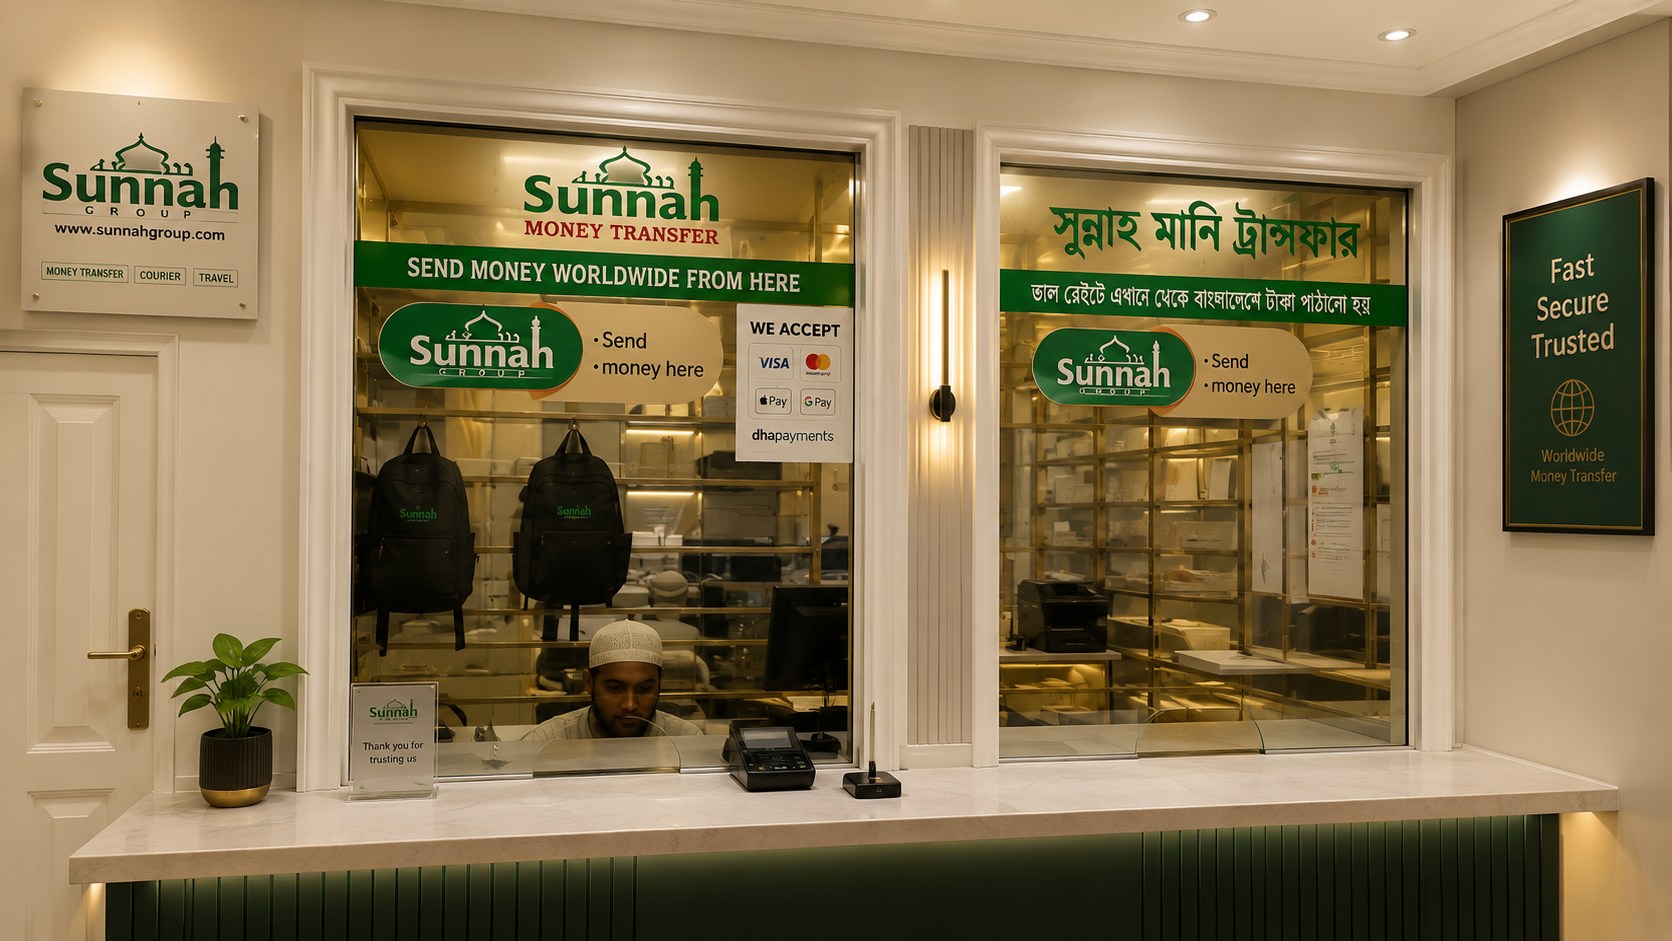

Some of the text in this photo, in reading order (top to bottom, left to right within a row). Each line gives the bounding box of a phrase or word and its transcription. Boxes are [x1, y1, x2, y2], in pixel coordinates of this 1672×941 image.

[42, 141, 239, 210] Sunnah
[523, 161, 720, 222] Sunnah
[85, 206, 192, 219] GROUP
[54, 223, 225, 242] www.sunnahgroup.com
[524, 219, 720, 245] MONEY TRANSFER
[1049, 200, 1361, 260] সুন্নাহ মানি ট্রান্সফার
[46, 266, 124, 279] MONEY TRANSFER
[139, 270, 181, 282] COURIER
[407, 256, 801, 294] SEND MONEY WORLDWIDE FROM HERE
[1551, 253, 1595, 284] Fast
[199, 273, 234, 284] TRAVEL
[1536, 292, 1609, 322] Secure
[750, 321, 840, 337] WE ACCEPT
[410, 321, 554, 369] Sunnah
[602, 331, 648, 349] Send
[1531, 323, 1615, 359] Trusted
[758, 357, 790, 369] VISA
[1057, 346, 1171, 388] Sunnah
[1212, 353, 1249, 369] Send
[602, 360, 704, 381] money here
[1212, 379, 1296, 397] money here
[769, 395, 788, 408] Pay
[814, 397, 832, 409] Pay
[752, 429, 834, 443] dhapayments
[1541, 448, 1605, 464] Worldwide
[1530, 468, 1617, 486] Money Transfer
[400, 507, 437, 519] Sunnah
[556, 505, 591, 516] Sunnah
[369, 700, 418, 718] Sunnah
[363, 741, 424, 752] Thank you for
[369, 755, 417, 765] trusting us
